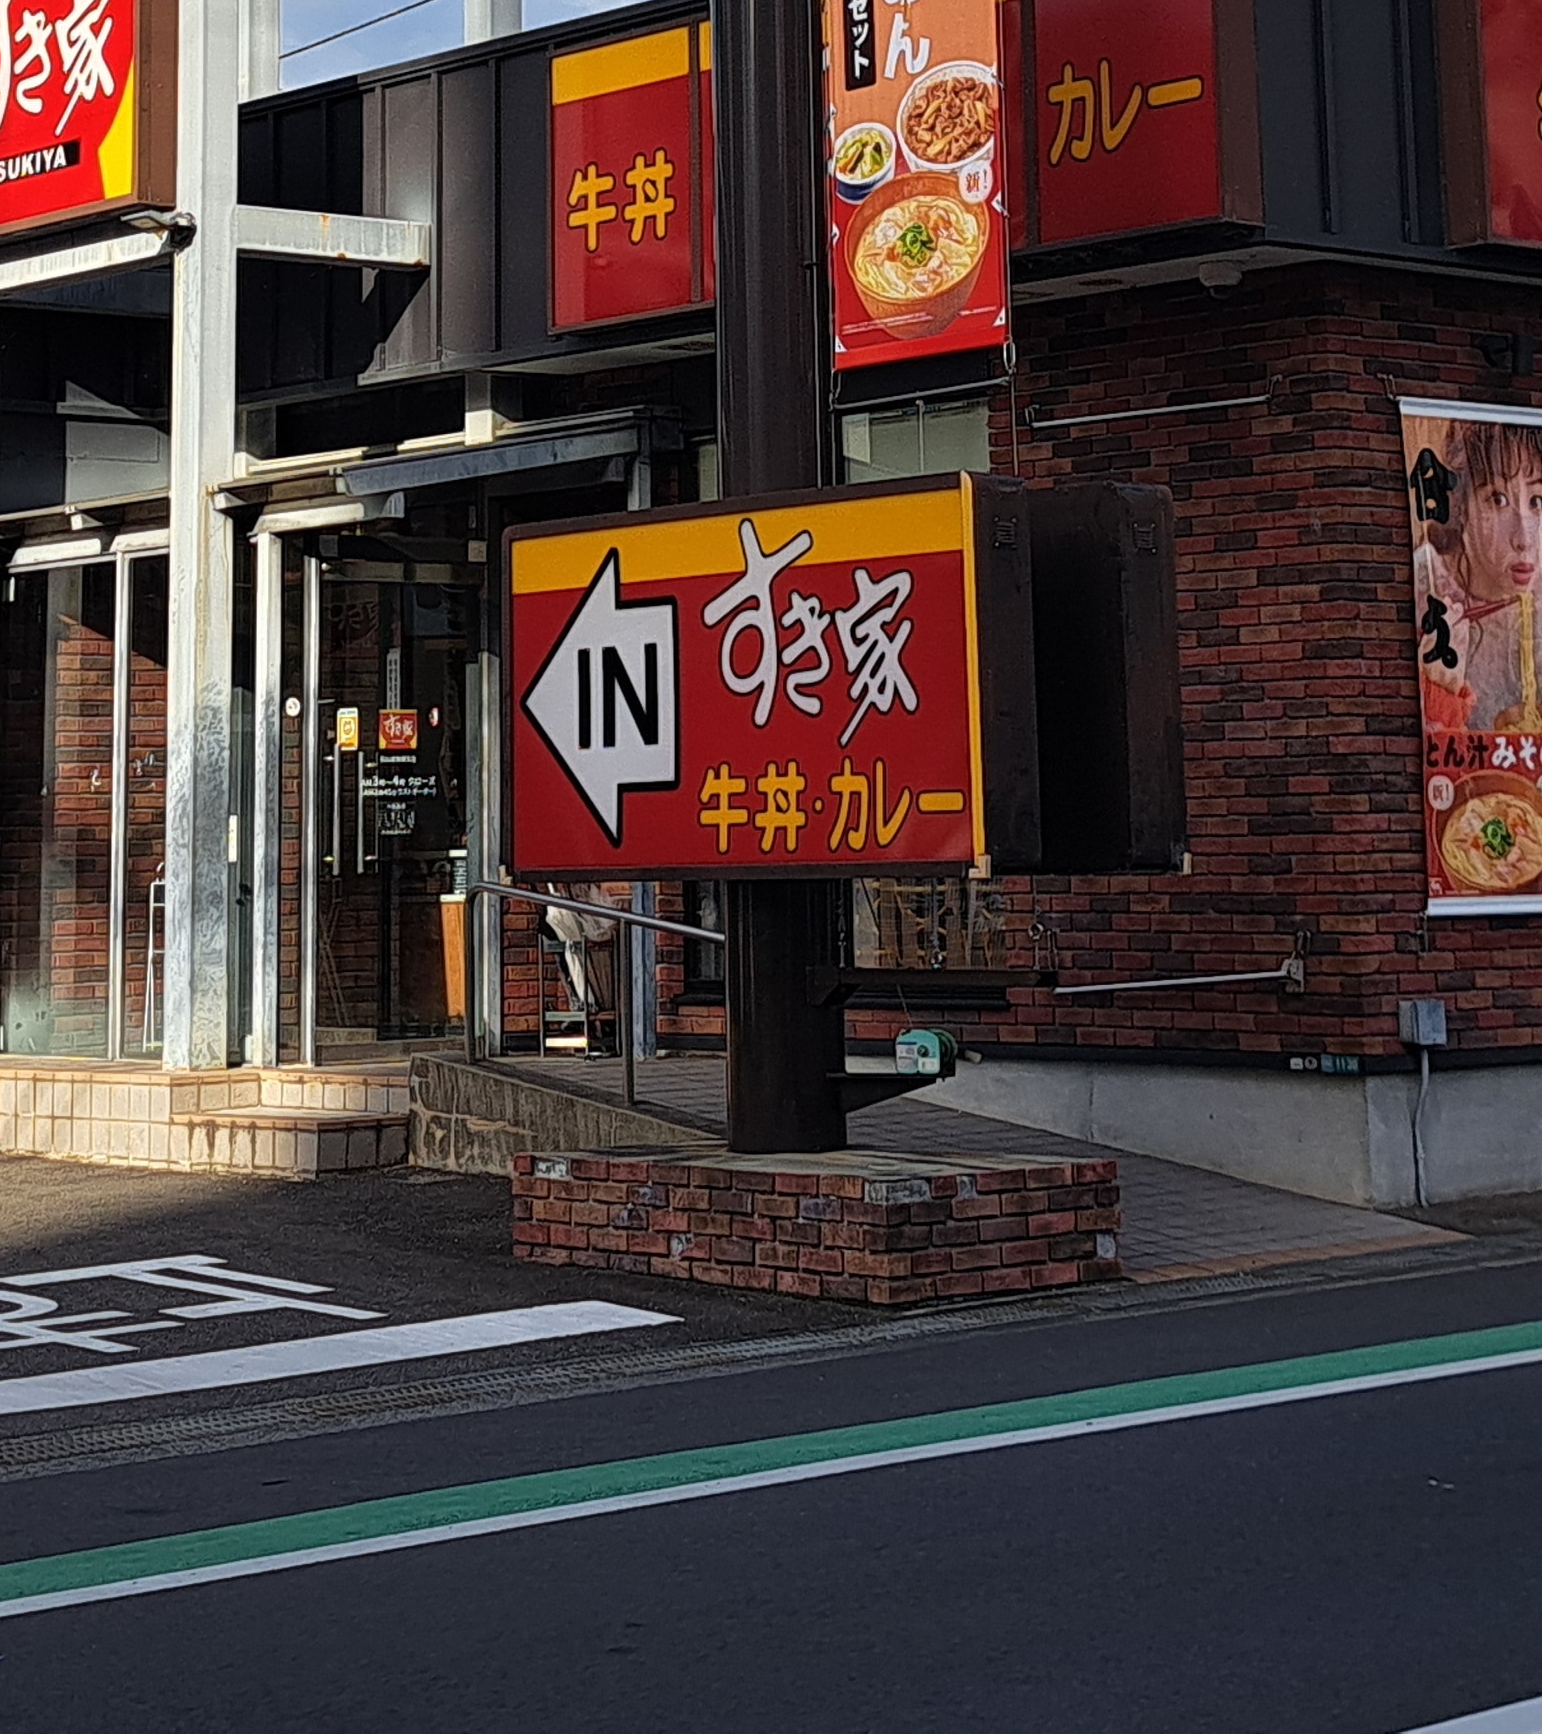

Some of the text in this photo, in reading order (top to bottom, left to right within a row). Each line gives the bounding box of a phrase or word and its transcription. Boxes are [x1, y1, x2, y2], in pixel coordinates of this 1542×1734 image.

[1046, 58, 1203, 166] カレー
[567, 147, 675, 254] 牛丼
[702, 518, 919, 748] すき家
[577, 642, 659, 750] IN
